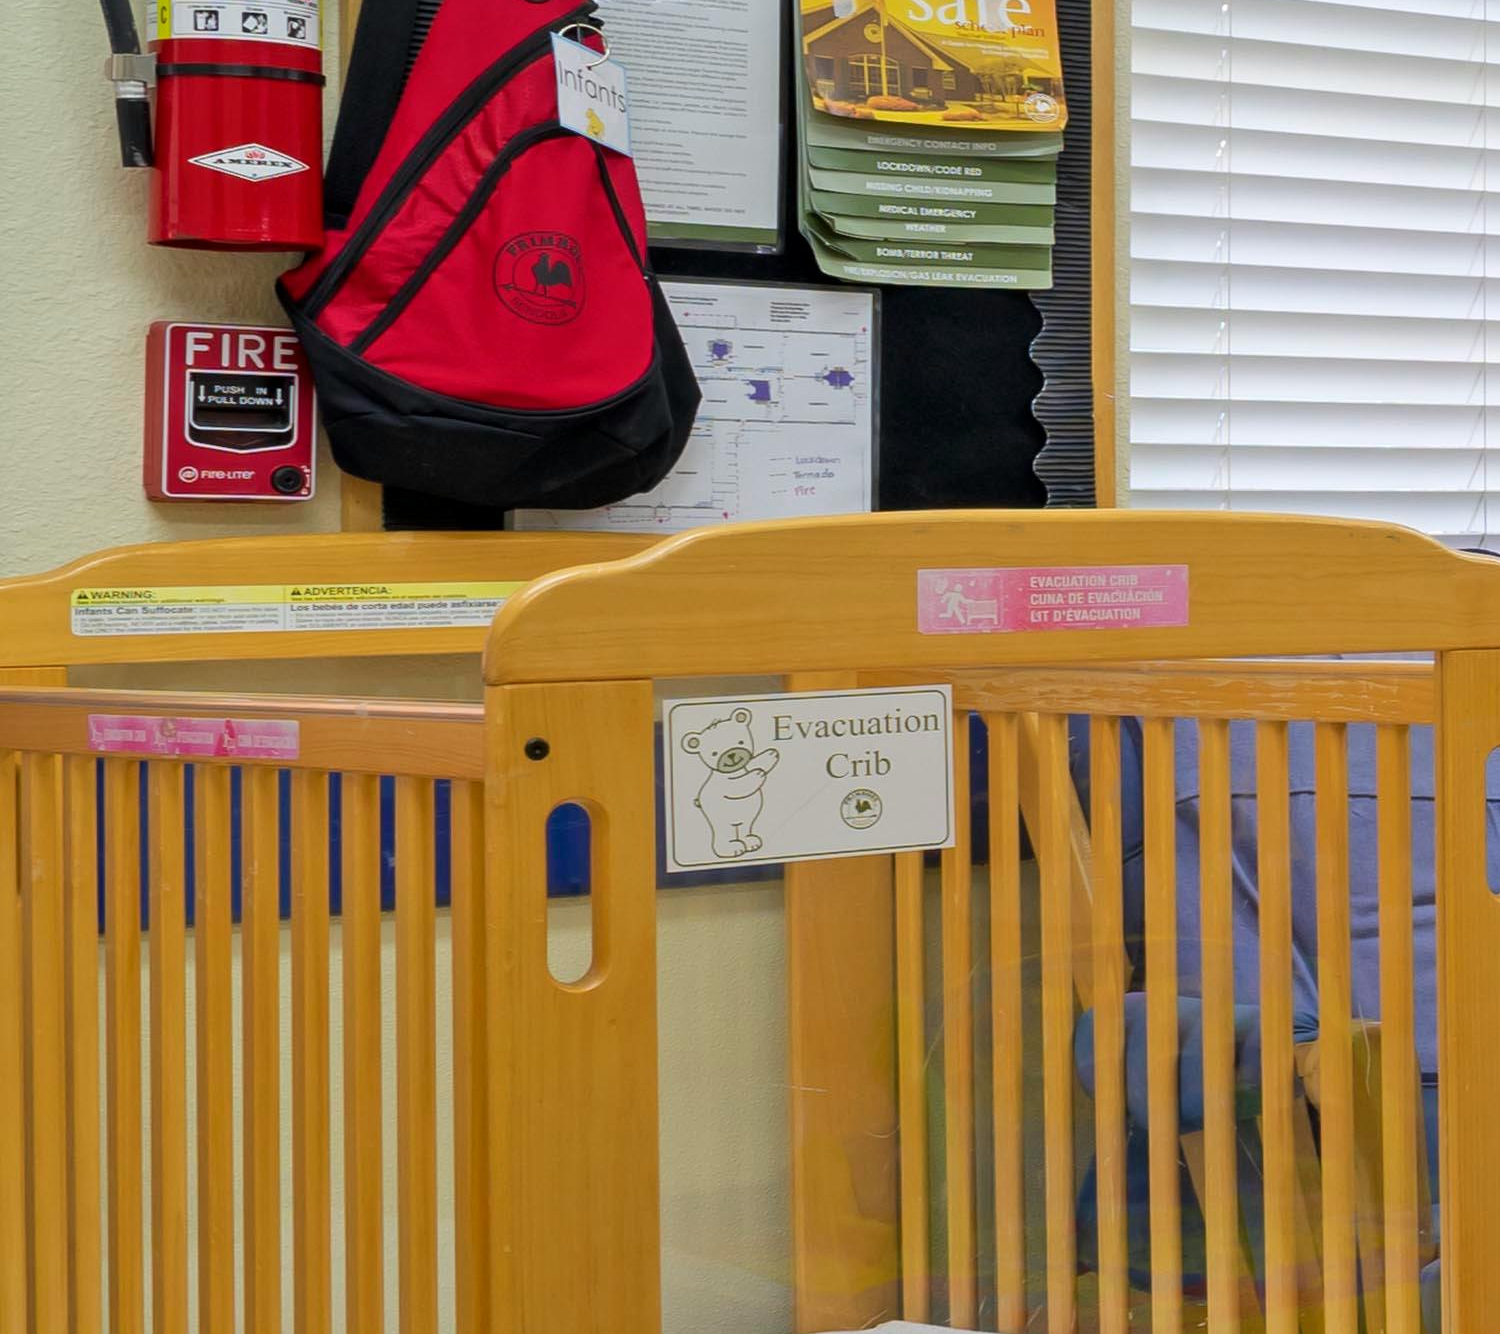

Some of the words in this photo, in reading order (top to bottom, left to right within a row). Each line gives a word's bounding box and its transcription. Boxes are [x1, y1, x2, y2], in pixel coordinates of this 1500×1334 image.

[160, 6, 167, 24] C
[1011, 23, 1045, 38] plan
[558, 60, 626, 113] Infants
[213, 158, 293, 168] AMEREX
[964, 167, 982, 176] RED
[879, 205, 918, 216] MEDICAL
[920, 207, 976, 218] EMERGENCY
[876, 247, 939, 260] BOMB/TERROR
[941, 251, 973, 261] THREAT
[932, 271, 953, 281] LEAK
[955, 273, 1017, 284] EVACUATION
[185, 331, 299, 370] FIRE
[214, 385, 245, 394] PUSH
[255, 387, 267, 395] IN
[207, 395, 236, 404] PULL
[239, 397, 274, 406] DOWN
[1029, 575, 1106, 588] EVACUATION
[1110, 574, 1138, 586] CRIB
[1030, 593, 1064, 605] CUNA
[1068, 592, 1086, 604] DE
[75, 606, 112, 615] Infants
[116, 606, 138, 615] Can
[290, 603, 309, 611] Los
[346, 602, 358, 611] de
[361, 602, 387, 611] corta
[390, 601, 414, 610] edad
[417, 601, 447, 611] puede
[1030, 610, 1049, 623] LIT
[773, 708, 941, 741] Evacuation
[825, 750, 891, 778] Crib
